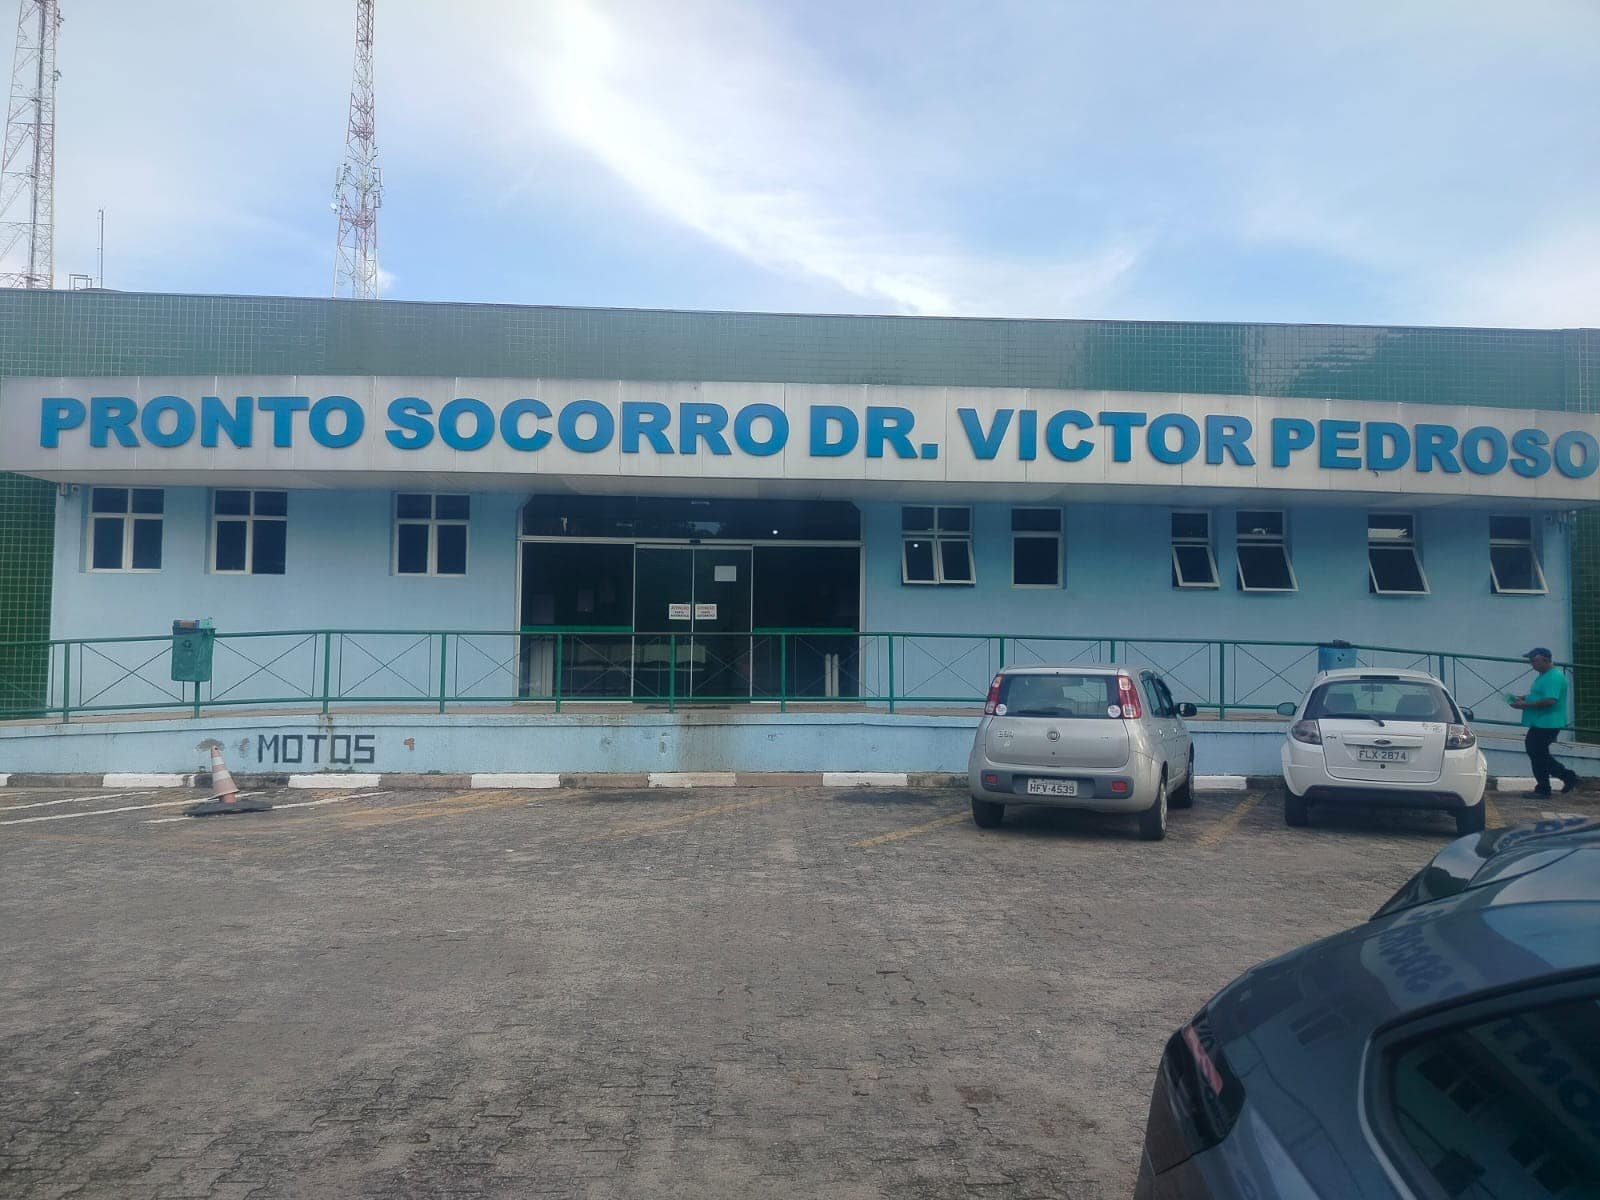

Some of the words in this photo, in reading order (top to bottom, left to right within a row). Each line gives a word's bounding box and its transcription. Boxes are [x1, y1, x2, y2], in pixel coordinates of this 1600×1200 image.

[40, 395, 365, 449] PRONTO
[384, 396, 790, 457] SOCORRO
[809, 405, 939, 460] DR.
[956, 407, 1257, 467] VICTOR
[1271, 417, 1599, 479] PEDROSO
[258, 734, 375, 764] MOTOS
